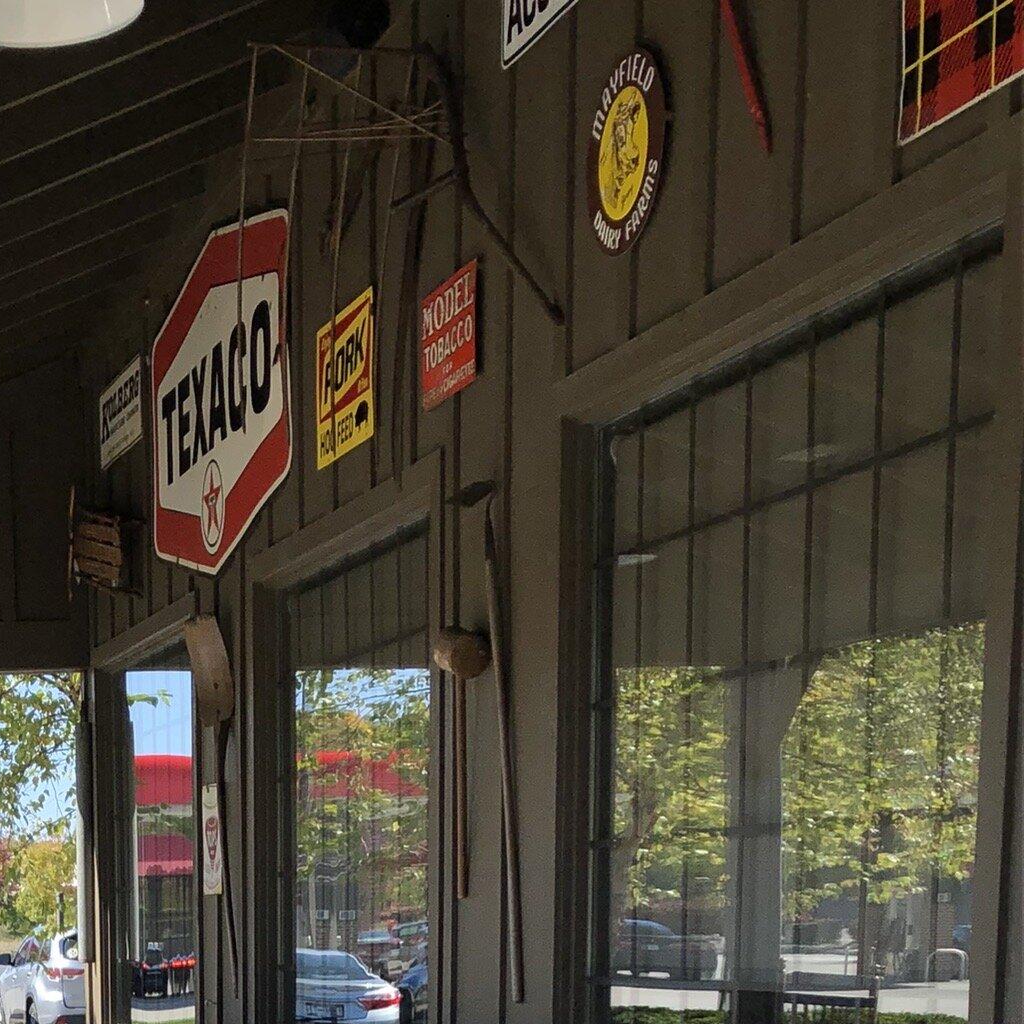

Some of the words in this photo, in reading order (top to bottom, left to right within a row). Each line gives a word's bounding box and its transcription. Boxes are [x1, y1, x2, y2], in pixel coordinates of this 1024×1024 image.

[592, 53, 655, 141] MAYFIELD
[593, 209, 622, 249] DAIRY
[625, 158, 659, 241] FARMS
[422, 272, 474, 341] MODEL
[424, 314, 473, 372] TOBACCO
[161, 299, 271, 487] TEXACO
